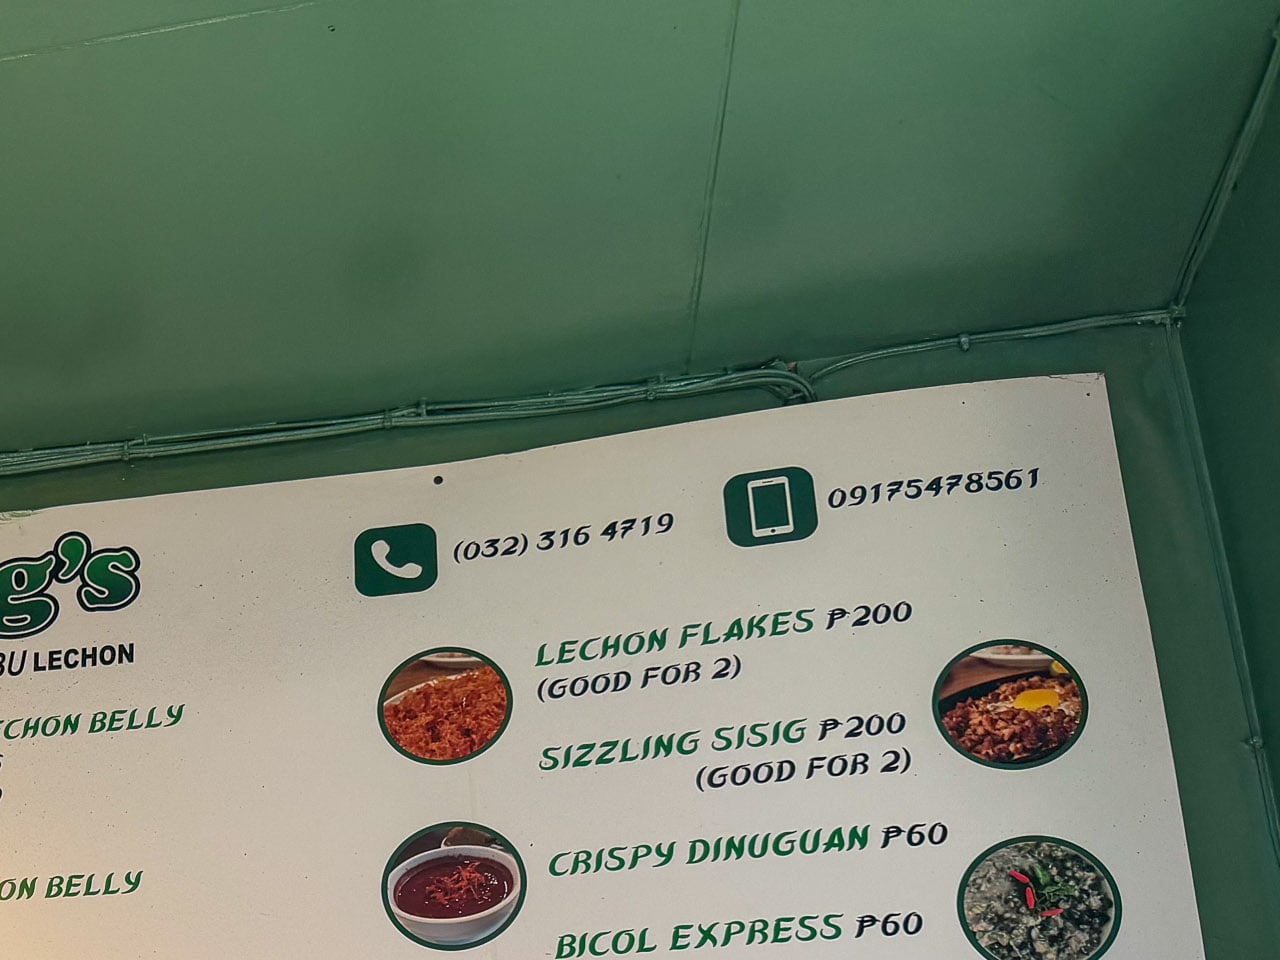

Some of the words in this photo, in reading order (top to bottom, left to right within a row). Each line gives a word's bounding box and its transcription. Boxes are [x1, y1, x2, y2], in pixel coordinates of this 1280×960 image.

[827, 467, 1040, 509] 09175478561
[453, 533, 529, 564] (032)
[536, 525, 591, 551] 316
[600, 513, 674, 542] 4719
[33, 642, 135, 673] LECHON
[534, 627, 669, 667] LECHON
[678, 608, 816, 649] FLAKES
[537, 670, 632, 703] (GOOD
[640, 661, 702, 689] FOR
[711, 654, 742, 680] 2)
[87, 703, 186, 734] BELLY
[538, 730, 701, 771] SIZZLING
[711, 718, 808, 752] SISIG
[696, 759, 796, 793] (GOOD
[805, 752, 870, 780] FOR
[880, 747, 911, 775] 2)
[548, 841, 677, 877] CRISPY
[685, 824, 871, 865] DINUGUAN
[44, 870, 144, 899] BELLY
[554, 927, 657, 960] BICOL
[668, 913, 844, 951] EXPRESS
